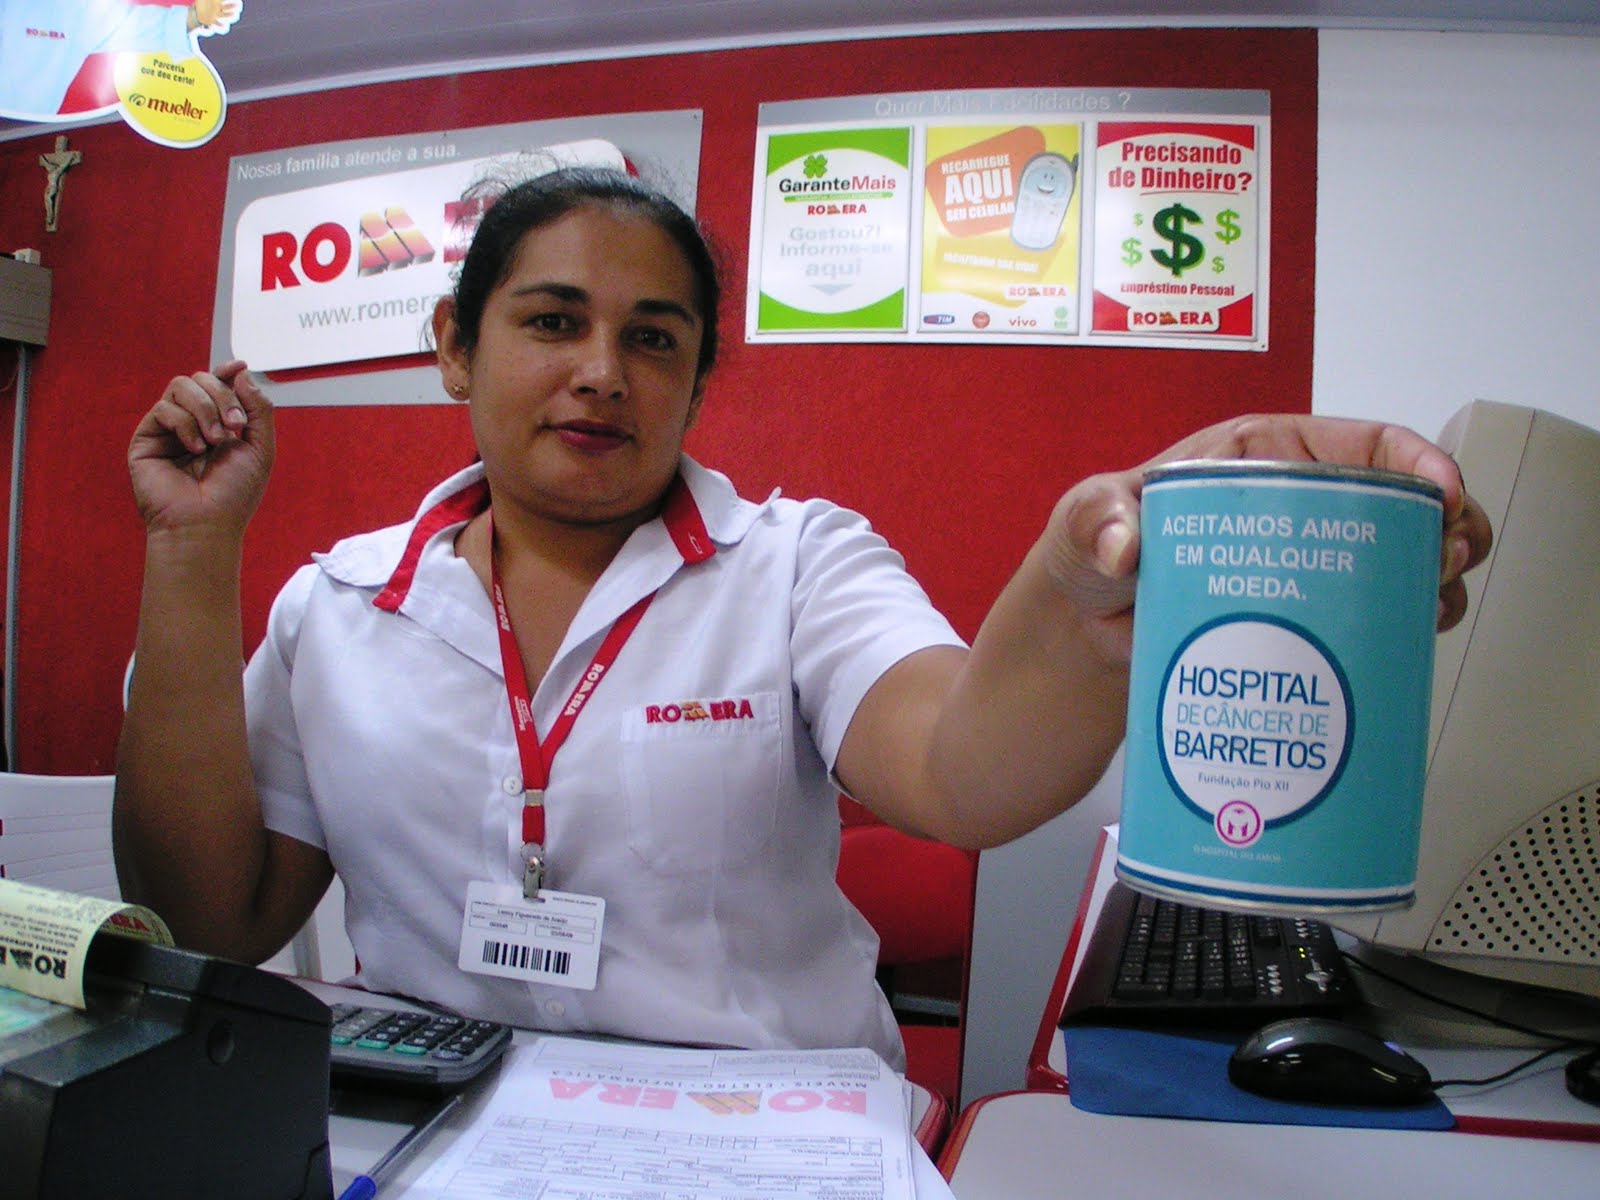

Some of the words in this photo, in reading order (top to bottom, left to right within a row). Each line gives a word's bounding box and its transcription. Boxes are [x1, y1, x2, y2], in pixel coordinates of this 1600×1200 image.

[147, 98, 207, 120] mueller
[874, 99, 924, 117] Quer
[237, 162, 281, 181] Nossa
[345, 146, 402, 167] atende
[407, 147, 417, 161] a
[1122, 142, 1242, 165] Precisando
[944, 167, 1013, 206] AQUI
[1108, 166, 1136, 188] de
[1141, 167, 1253, 191] Dinheiro?
[807, 204, 867, 215] ROMERA
[945, 207, 967, 223] SEU
[805, 258, 862, 280] aqui
[1120, 281, 1188, 295] Empréstimo
[1189, 283, 1235, 297] Pessoal
[1008, 316, 1037, 327] vivo
[1133, 311, 1214, 326] ROMERA
[1162, 513, 1293, 537] ACEITAMOS
[1301, 517, 1377, 544] AMOR
[1175, 544, 1203, 566] EM
[1210, 544, 1354, 572] QUALQUER
[1208, 574, 1307, 600] MOEDA.
[564, 663, 605, 716] ROMERA
[1179, 664, 1330, 706] HOSPITAL
[646, 699, 754, 724] ROMERA
[1177, 702, 1201, 726] DE
[1203, 701, 1294, 735] CÂNCER
[1299, 713, 1329, 737] DE
[1174, 728, 1327, 770] BARRETOS
[1197, 771, 1250, 789] Fundação
[1253, 778, 1272, 791] Pio
[1274, 780, 1290, 791] XII
[549, 1078, 867, 1116] ROMERA
